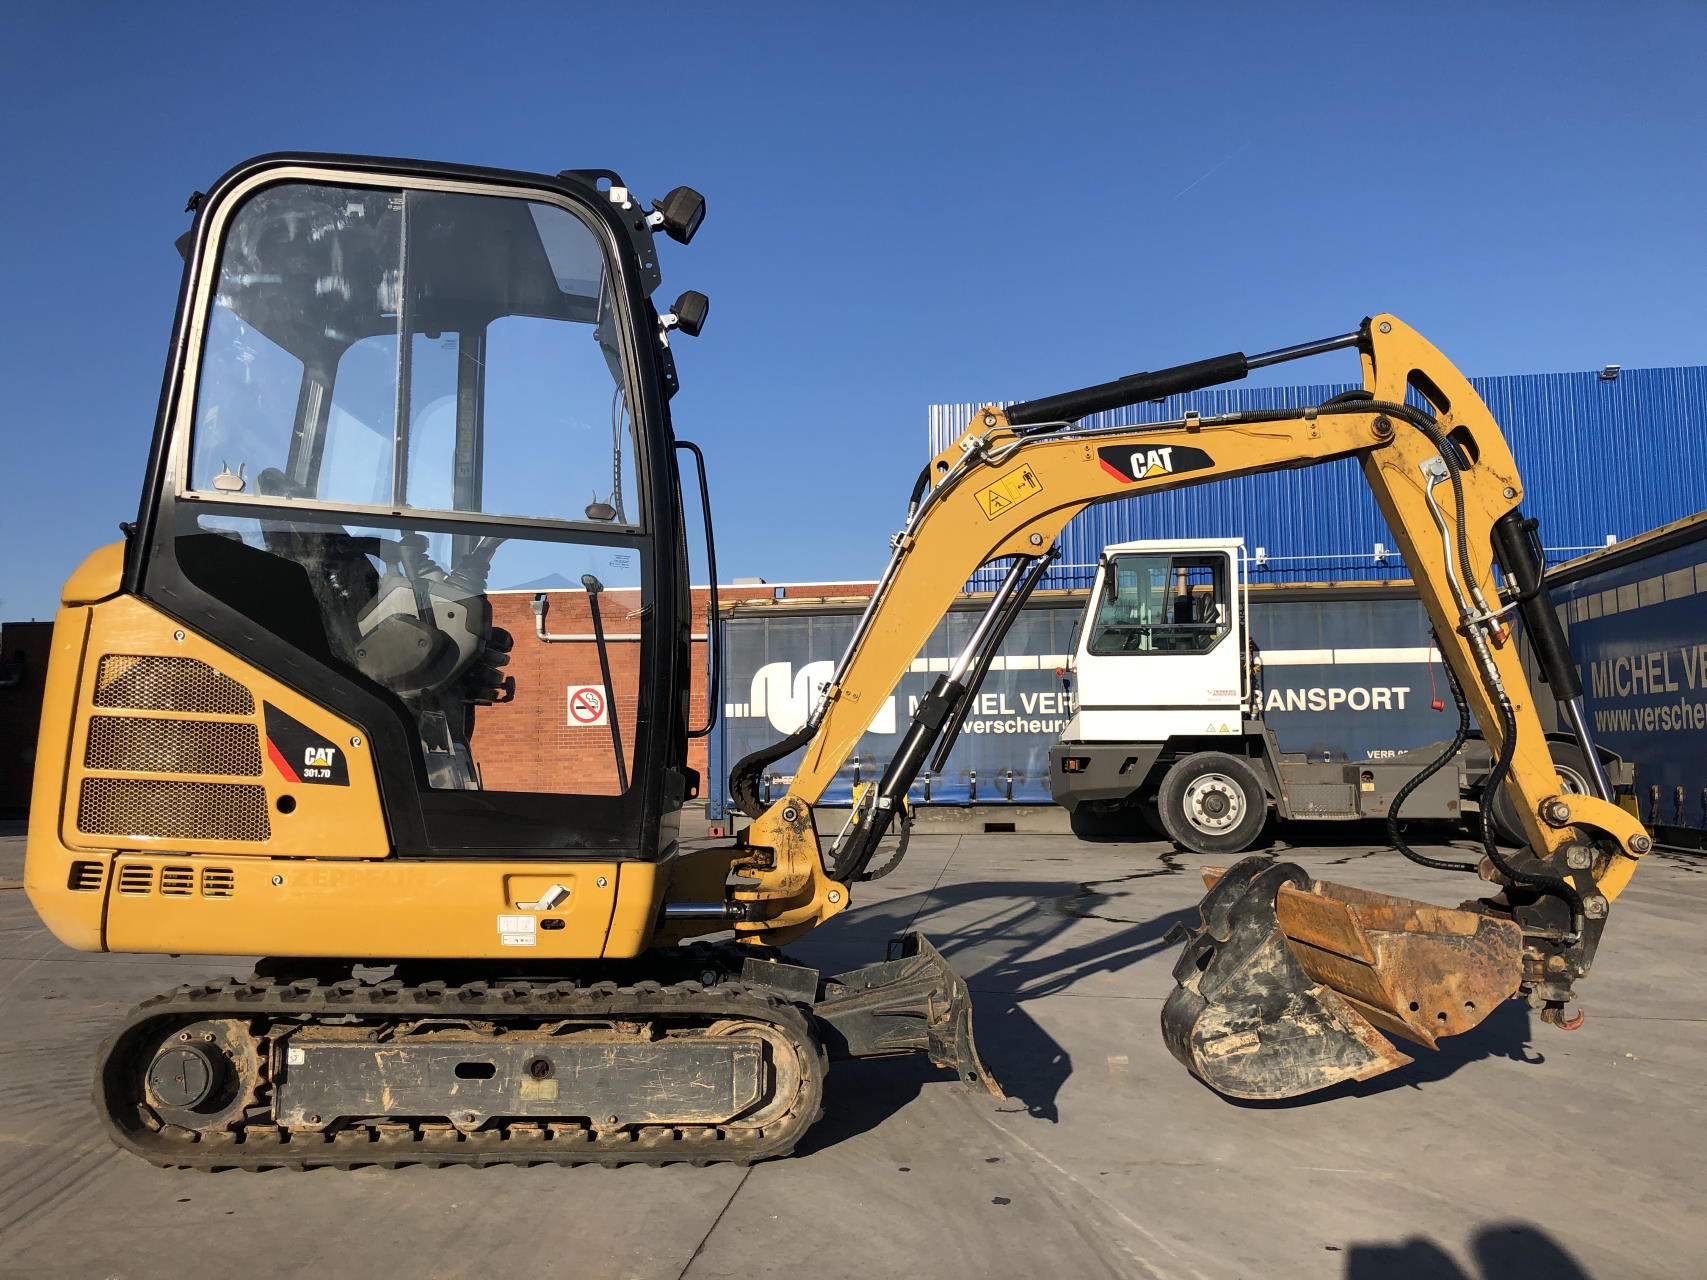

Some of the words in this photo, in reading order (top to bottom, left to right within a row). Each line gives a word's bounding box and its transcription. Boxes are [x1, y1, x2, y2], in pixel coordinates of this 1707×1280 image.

[1130, 447, 1173, 479] CAT
[1591, 650, 1679, 698] MICHEL
[1594, 696, 1707, 732] www.versche
[304, 747, 336, 767] CAT
